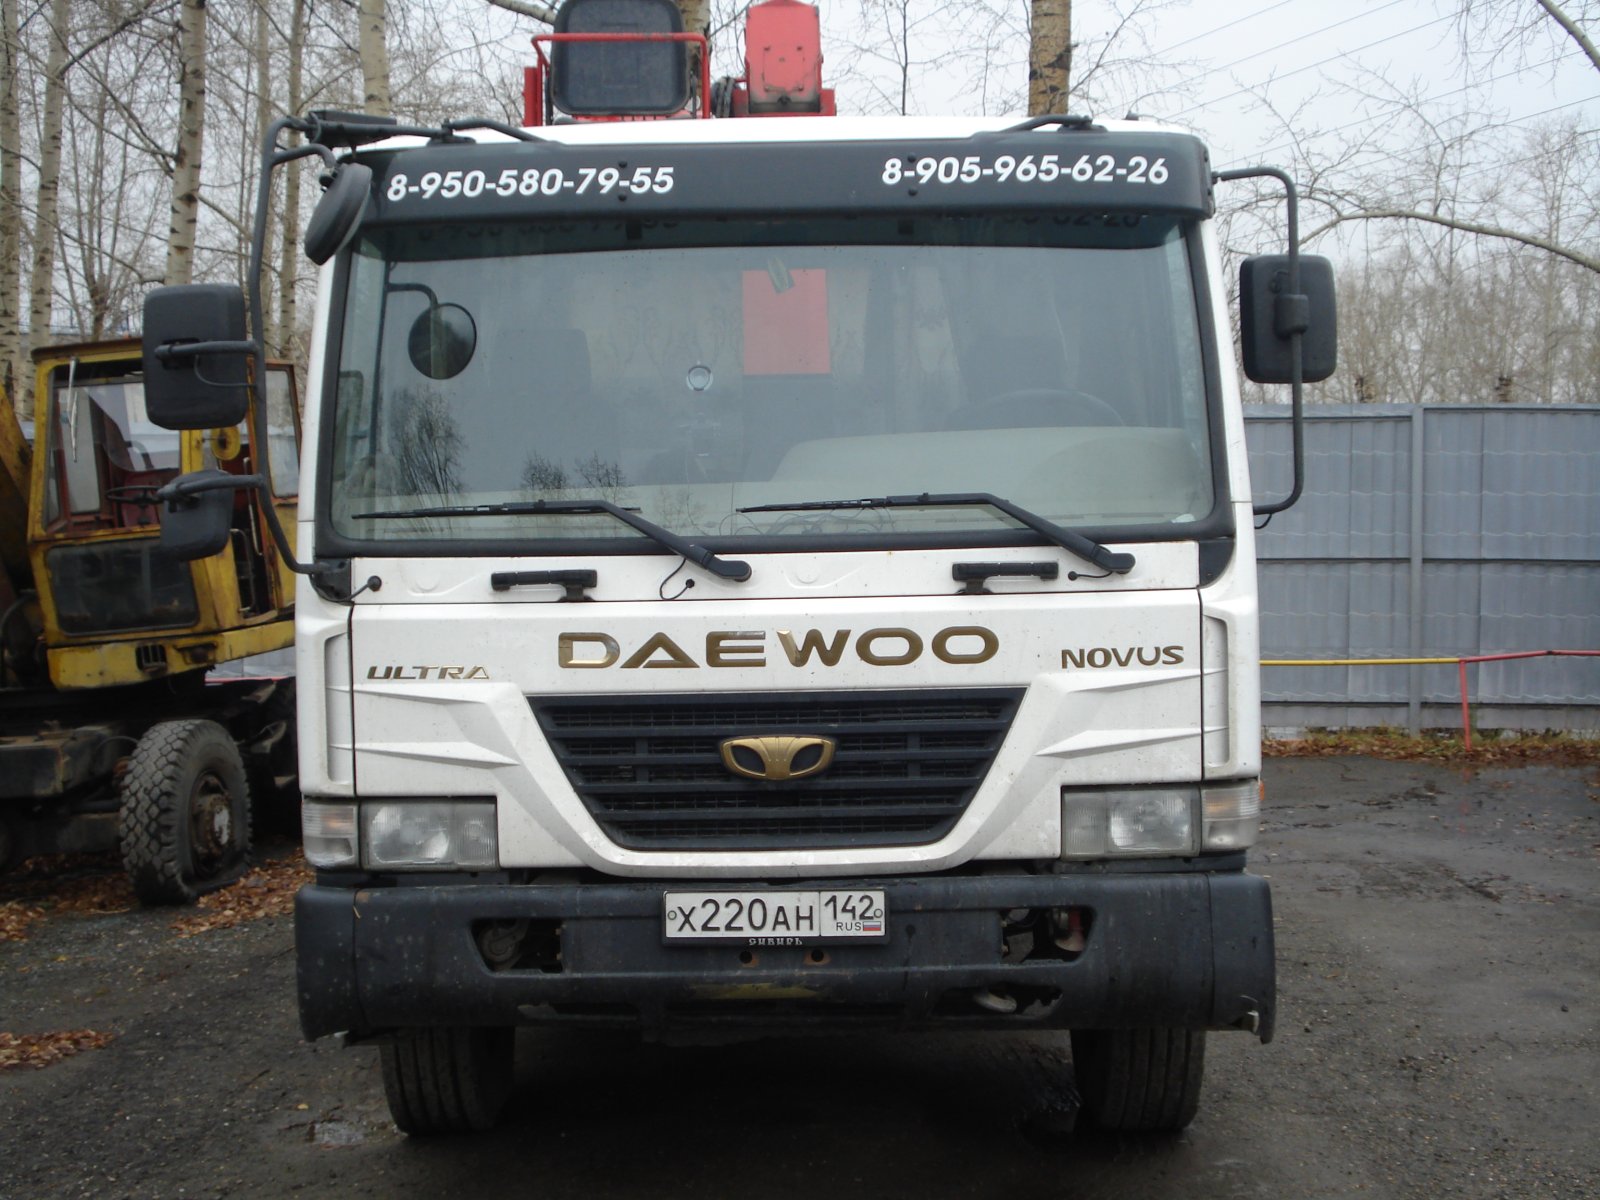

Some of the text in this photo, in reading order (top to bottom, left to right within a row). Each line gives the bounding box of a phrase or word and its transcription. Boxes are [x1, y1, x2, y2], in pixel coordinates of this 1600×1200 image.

[882, 154, 1169, 185] 8-905-965-62-26
[386, 166, 675, 202] 8-950-580-79-55
[557, 625, 1000, 669] DAEWOO
[1061, 645, 1185, 669] NOVUS
[367, 665, 491, 680] ULTRA
[824, 894, 875, 921] 142
[835, 921, 862, 932] RUS
